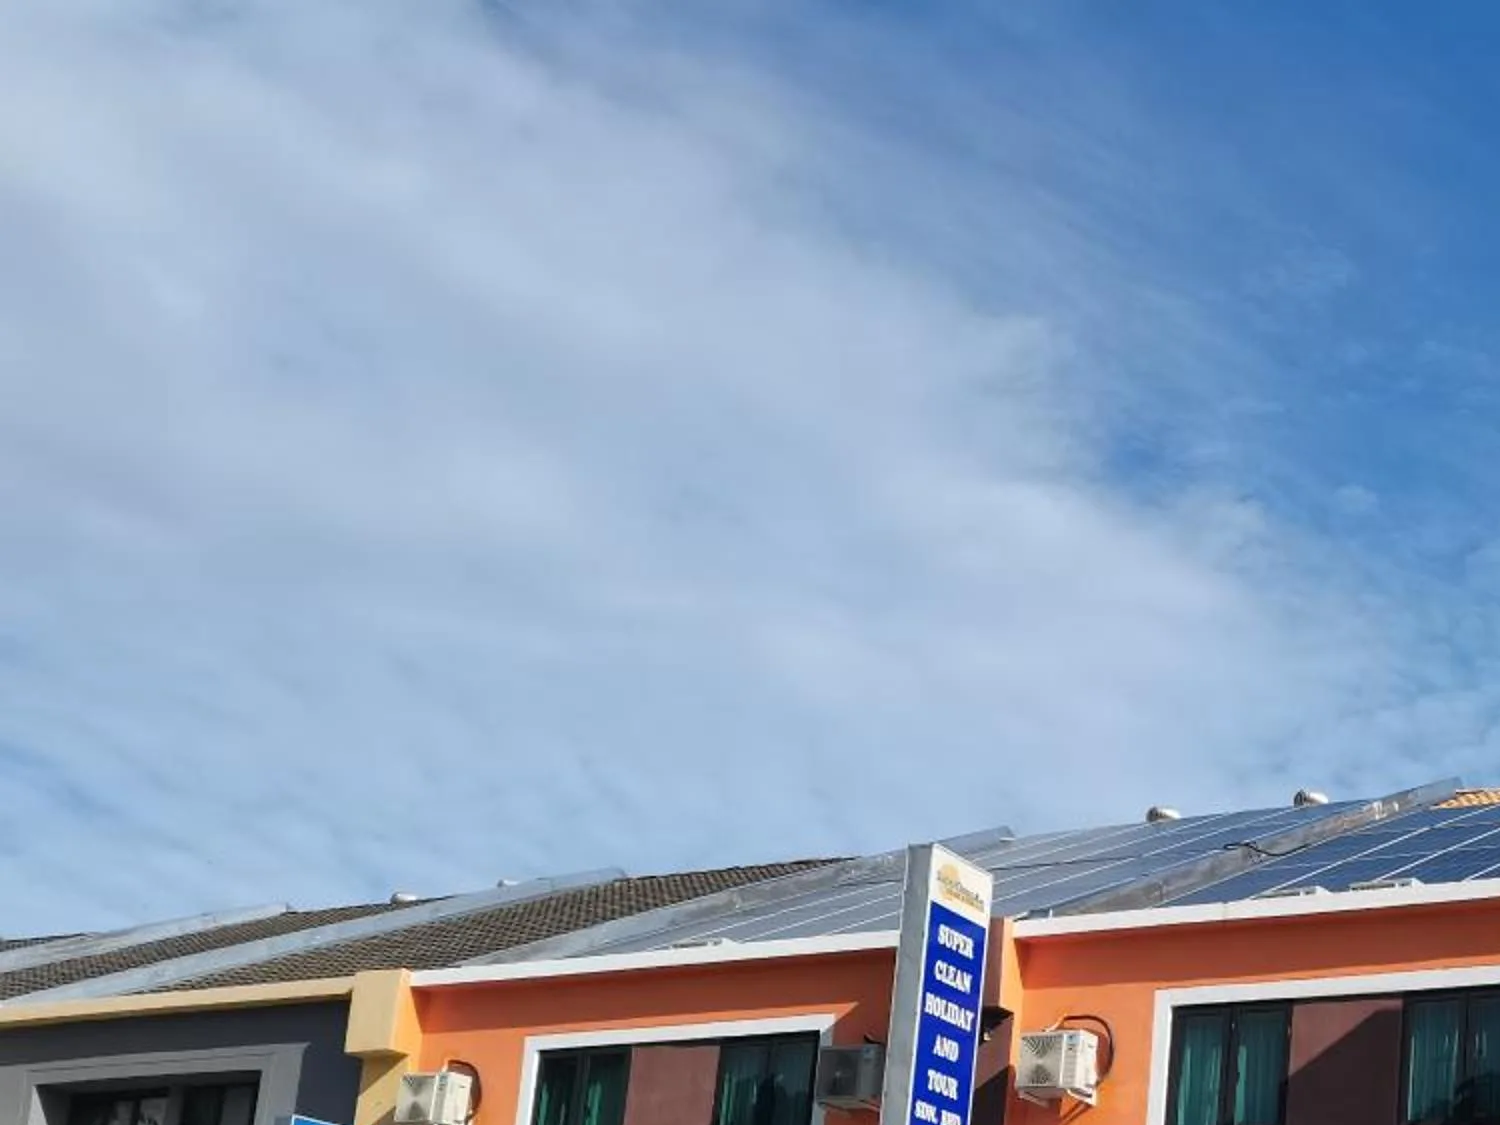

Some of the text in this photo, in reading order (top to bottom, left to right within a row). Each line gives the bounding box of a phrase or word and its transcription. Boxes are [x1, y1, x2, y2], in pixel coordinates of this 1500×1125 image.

[937, 922, 974, 959] SUPER
[934, 958, 973, 995] CLEAN
[924, 991, 975, 1033] HOLIDAY
[932, 1034, 959, 1063] AND
[926, 1068, 959, 1101] TOUR
